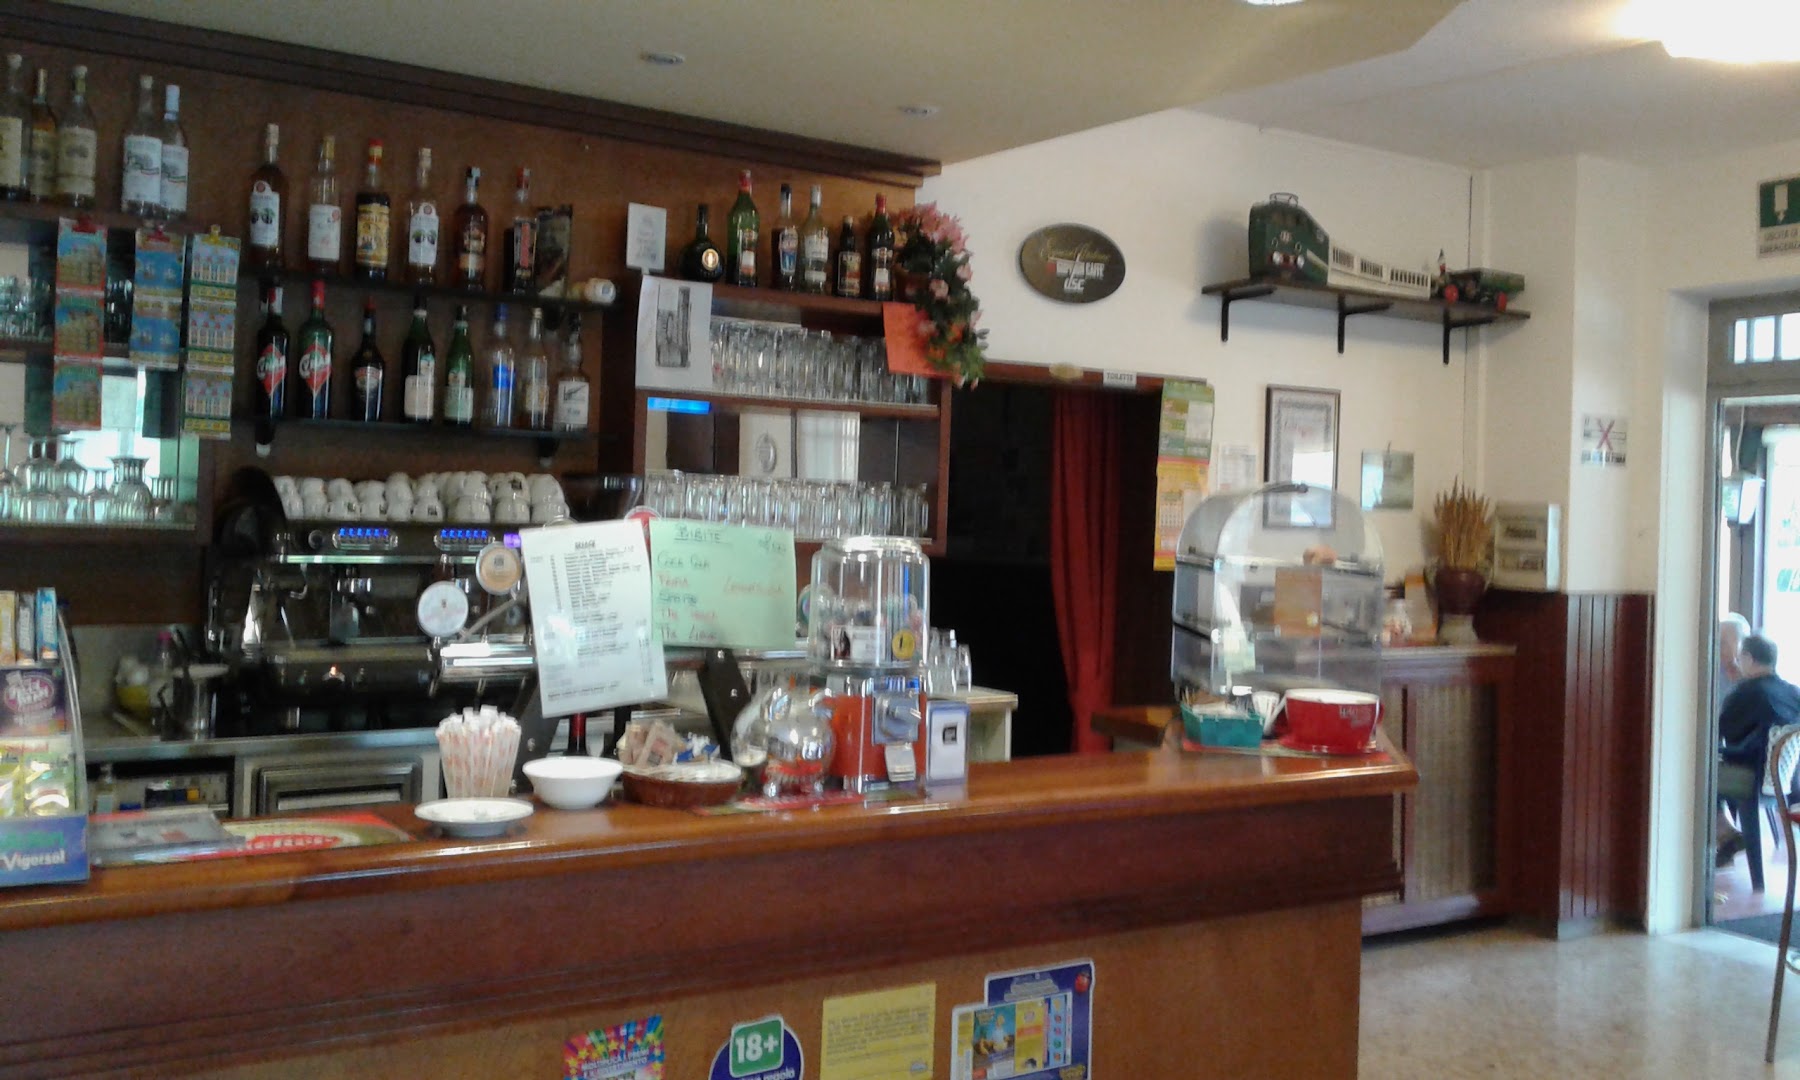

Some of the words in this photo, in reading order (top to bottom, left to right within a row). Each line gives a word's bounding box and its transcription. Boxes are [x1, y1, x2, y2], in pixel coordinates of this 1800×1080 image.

[1106, 372, 1134, 381] TOILETTE
[675, 522, 720, 543] BIBITE
[4, 848, 65, 871] Vigorsol
[735, 1033, 779, 1063] 18+
